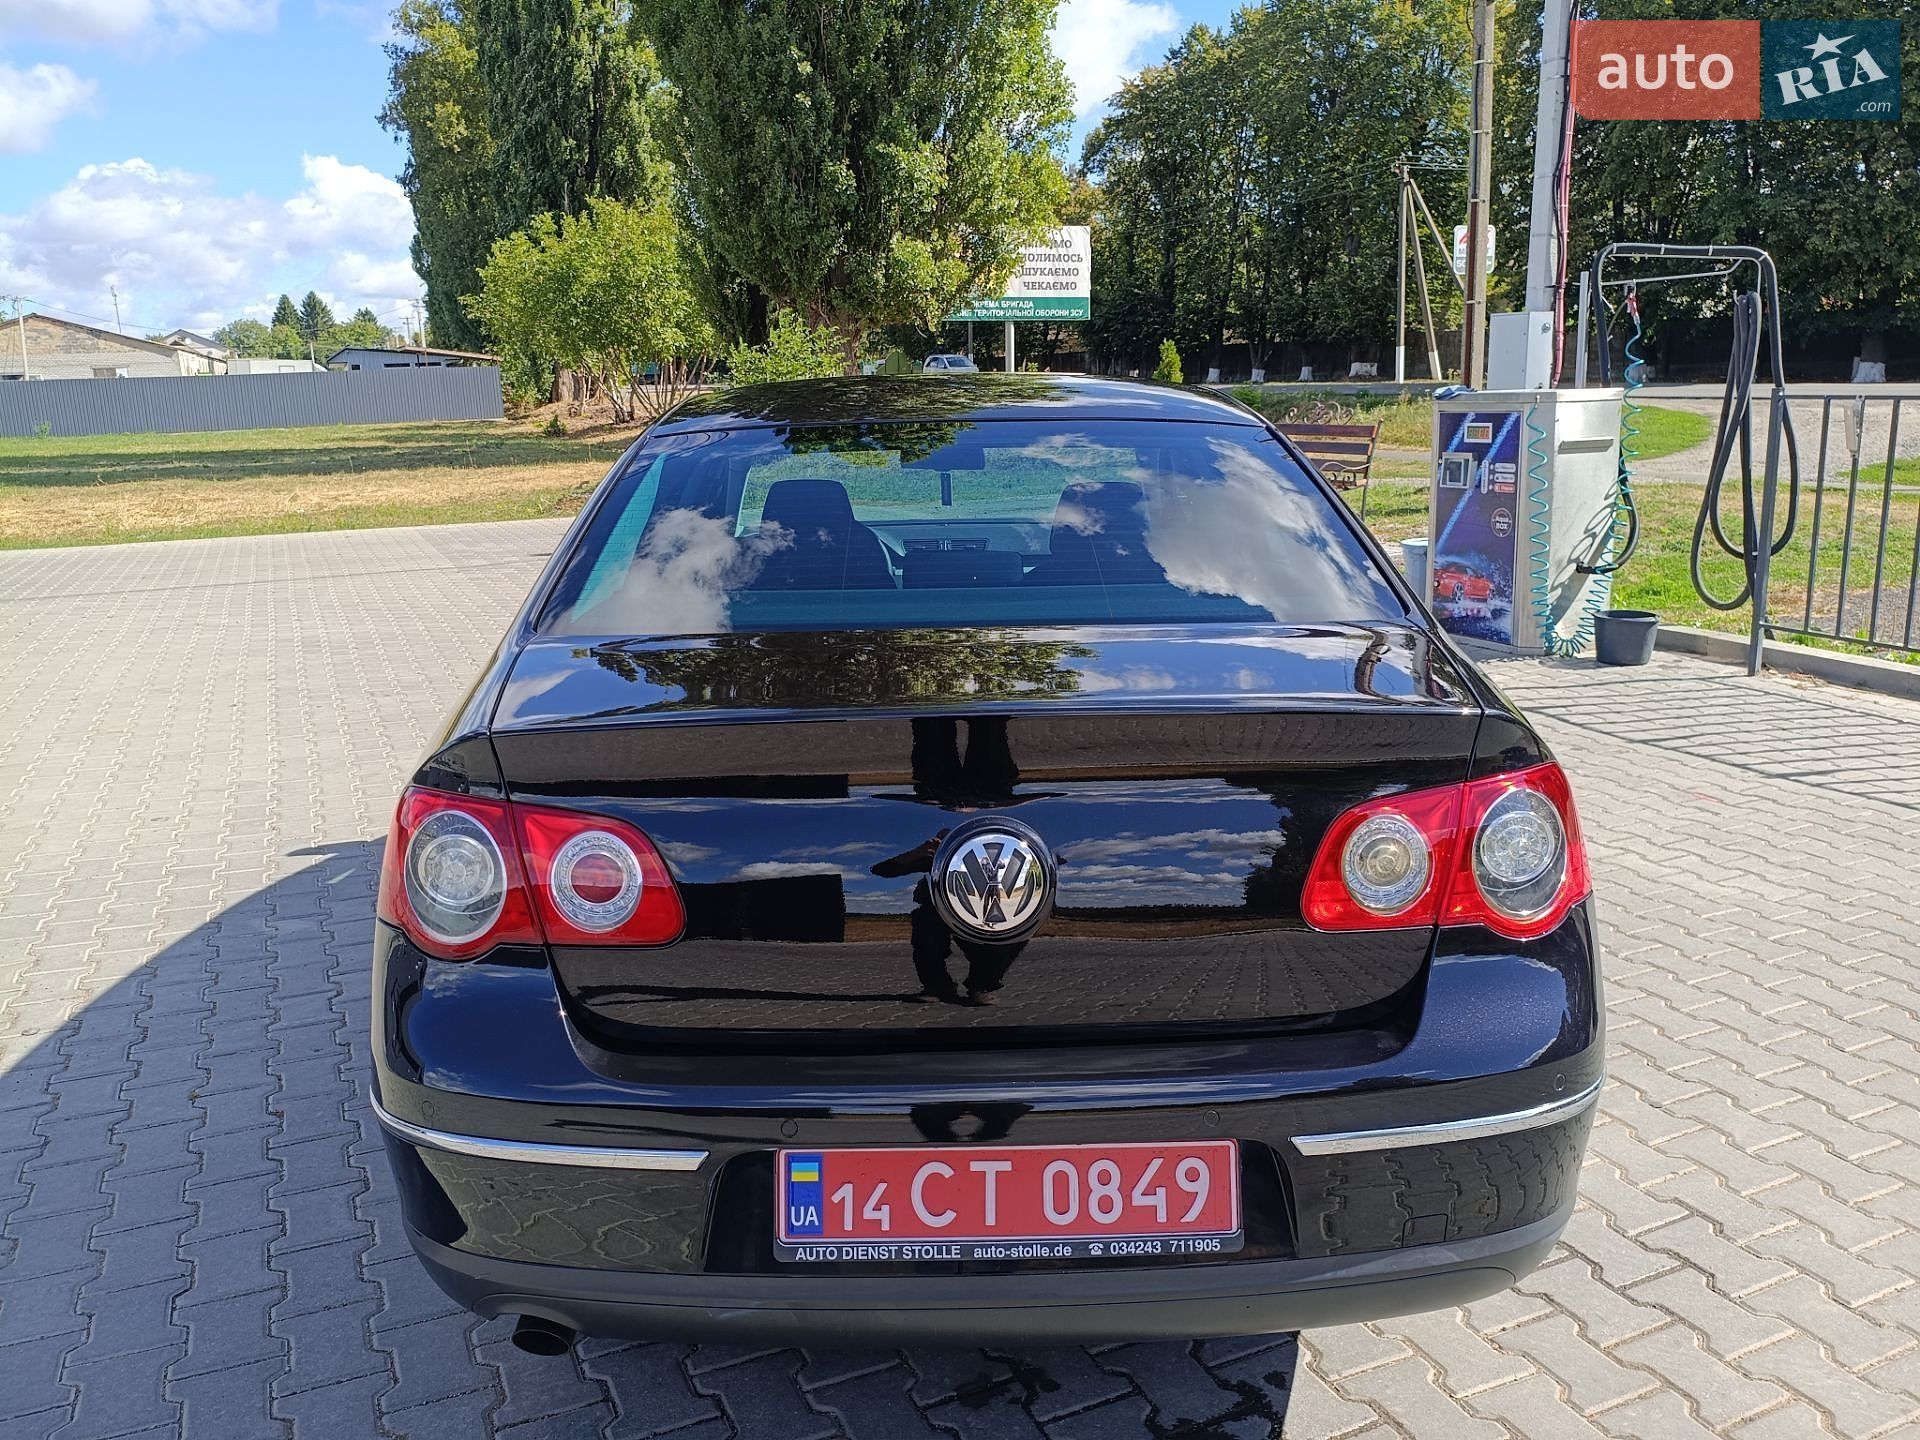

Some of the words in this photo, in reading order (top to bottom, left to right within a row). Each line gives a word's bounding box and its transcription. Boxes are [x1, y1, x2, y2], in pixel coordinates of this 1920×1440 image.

[1023, 281, 1077, 290] ЧЕКАЄМО
[1001, 300, 1034, 308] БРИГАДА
[974, 308, 1034, 317] ТЕРИТОРІАЛЬНОЇ
[1035, 309, 1069, 317] ОБОРОНИ
[1070, 309, 1083, 317] ЗСУ
[831, 1182, 891, 1232] 14
[911, 1160, 1012, 1228] CT
[1042, 1155, 1210, 1226] 0849
[790, 1205, 819, 1226] UA
[795, 1247, 838, 1261] AUTO
[842, 1246, 898, 1260] DIENST
[902, 1245, 961, 1259] STOLLE
[973, 1243, 1072, 1259] auto-stolle.de
[1110, 1240, 1162, 1255] 034243
[1169, 1238, 1221, 1253] 711905
